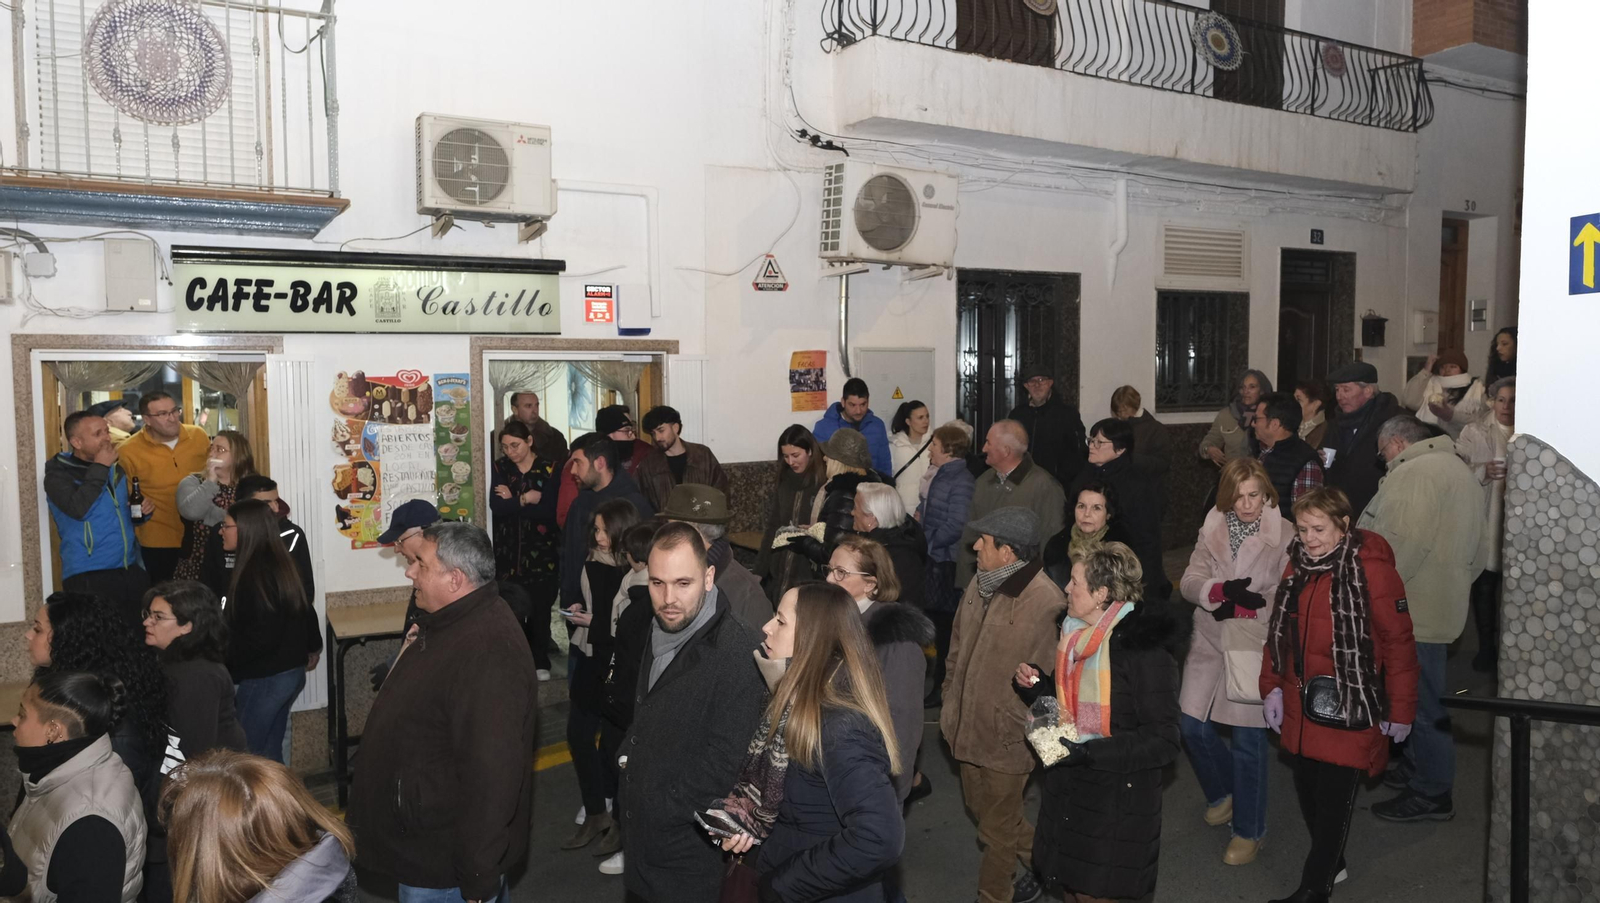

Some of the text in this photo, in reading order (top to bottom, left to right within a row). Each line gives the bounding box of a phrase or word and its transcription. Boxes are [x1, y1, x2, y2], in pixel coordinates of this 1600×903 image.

[1464, 200, 1477, 211] 30
[1312, 231, 1322, 242] 32
[185, 277, 358, 317] CAFE-BAR
[416, 285, 554, 317] Castillo
[381, 433, 432, 443] ABIERTOS
[382, 444, 414, 455] DESDE
[418, 451, 431, 459] EN
